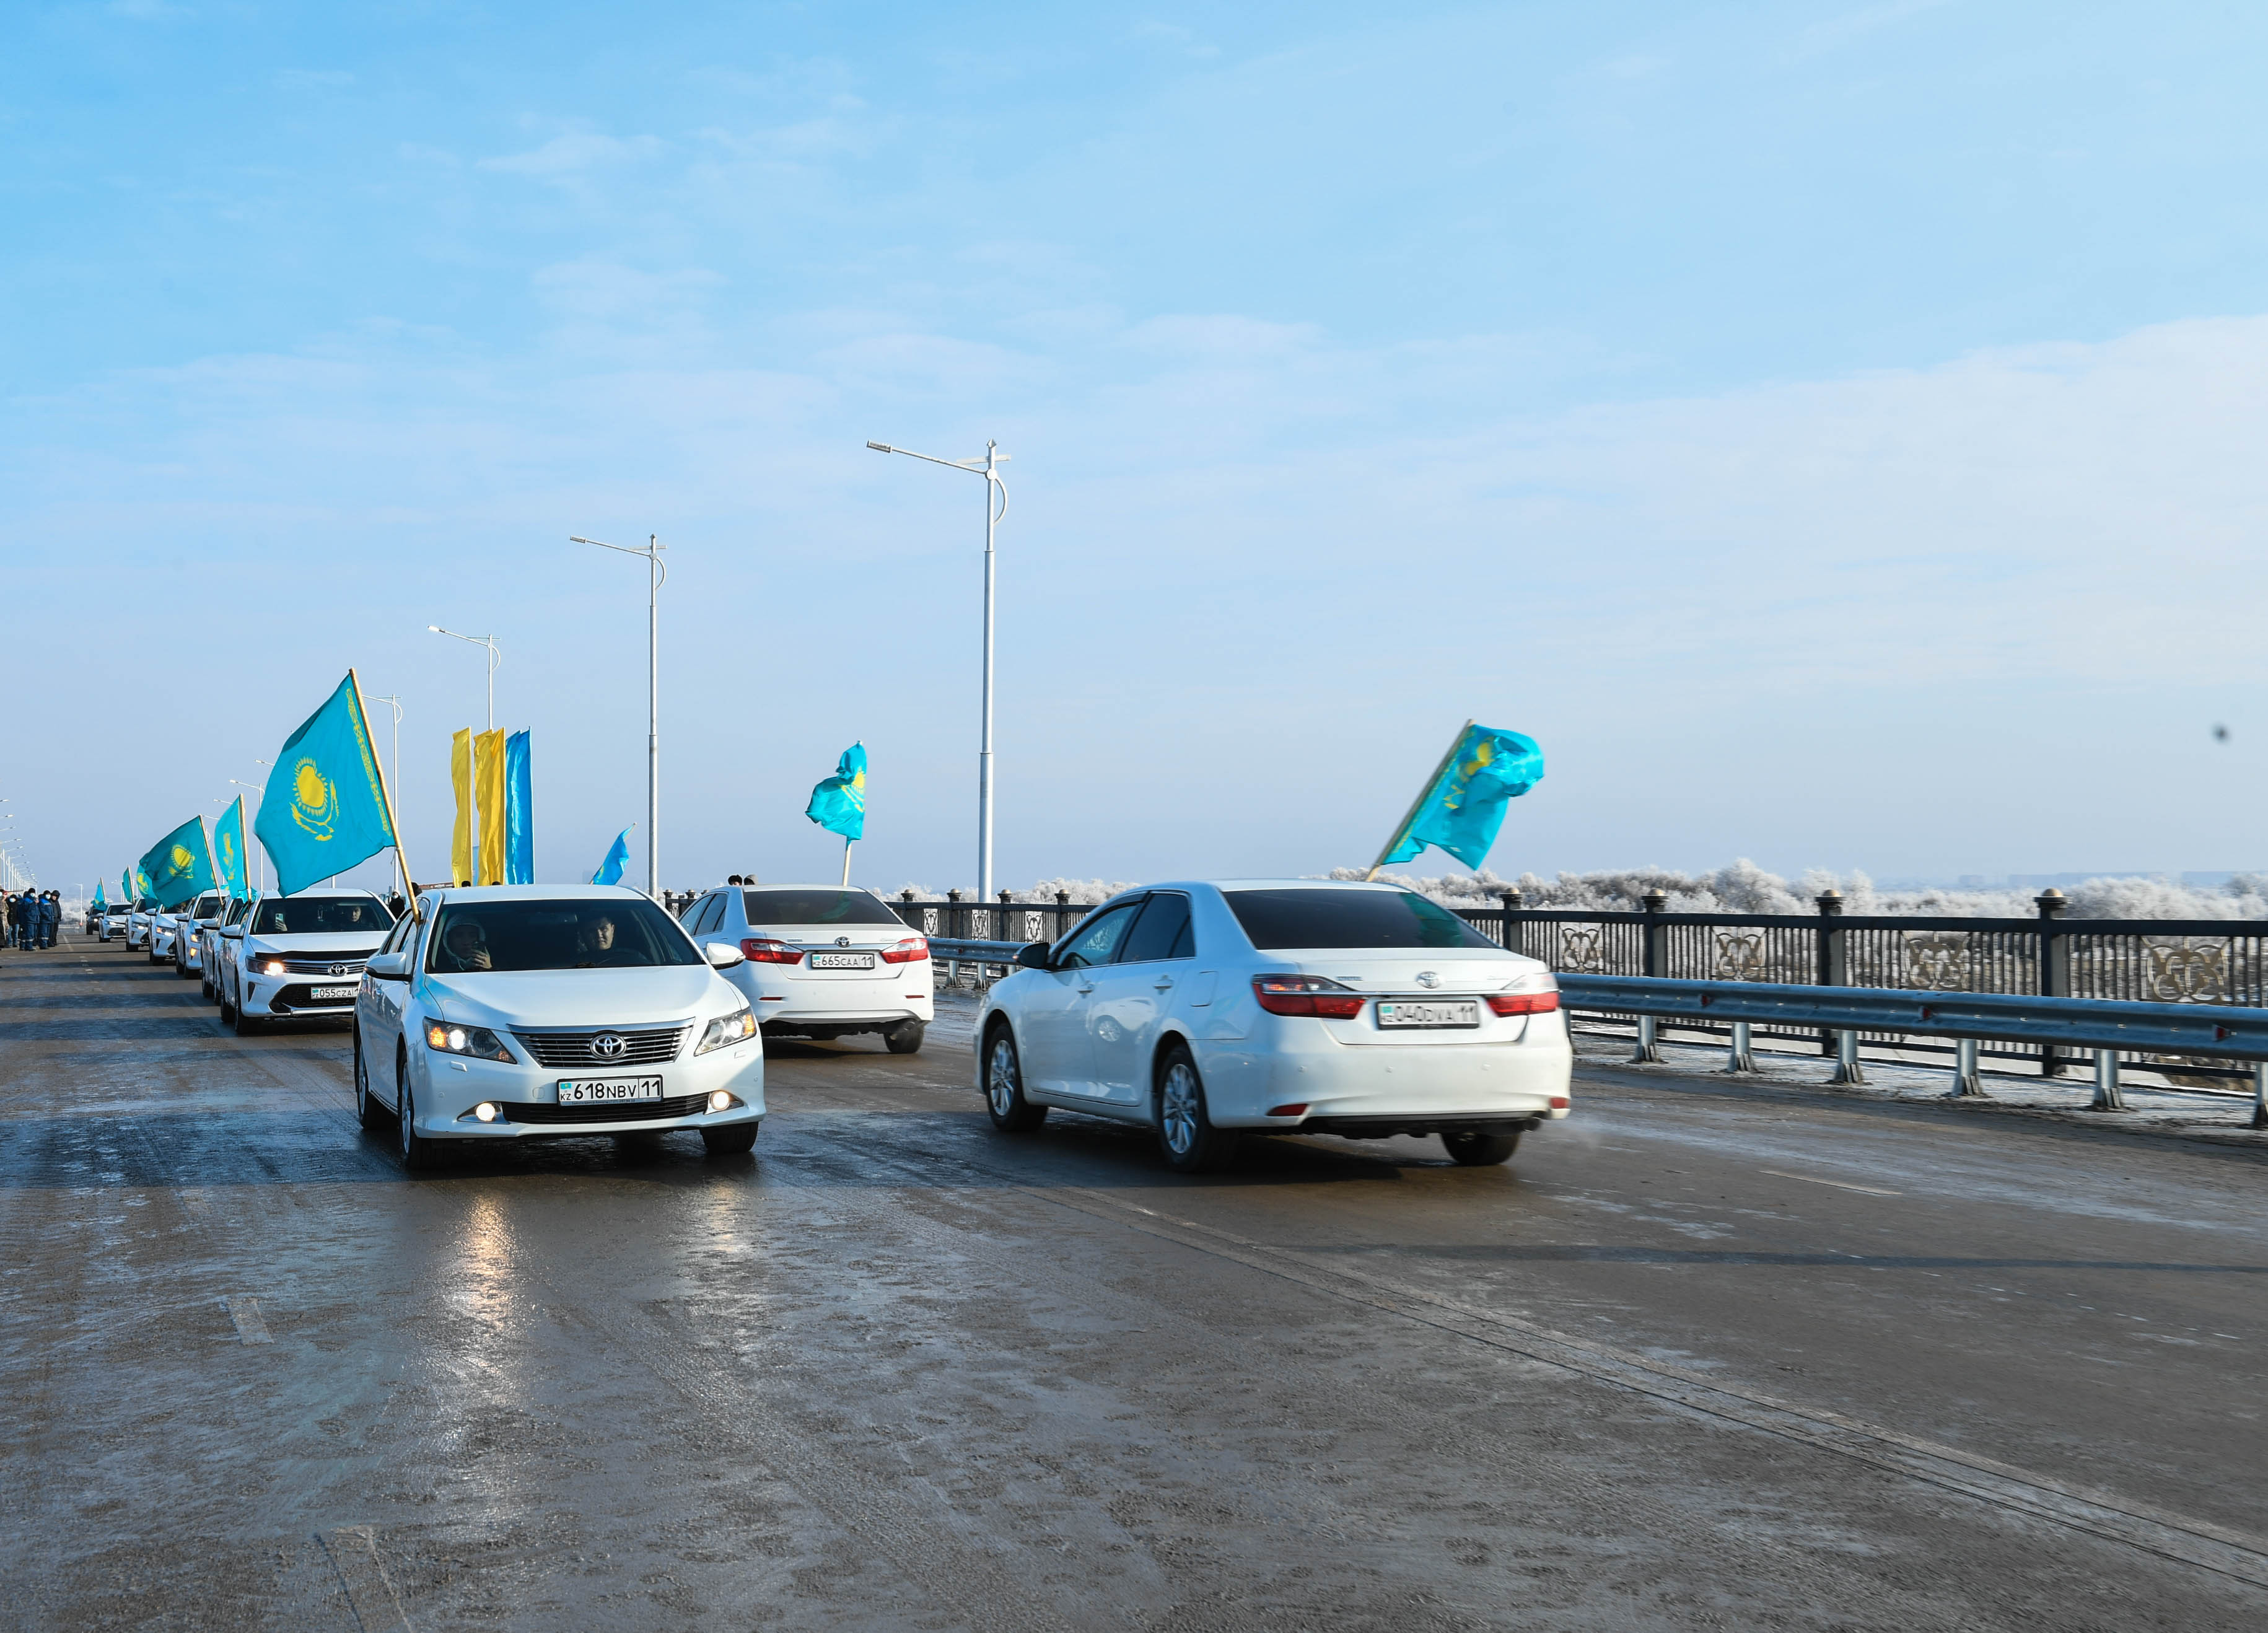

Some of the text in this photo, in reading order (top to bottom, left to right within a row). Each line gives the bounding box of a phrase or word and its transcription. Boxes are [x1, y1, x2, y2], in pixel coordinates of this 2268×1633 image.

[821, 956, 858, 966] 665CAA
[861, 956, 873, 966] 11
[320, 989, 352, 997] 055CZA
[574, 1082, 637, 1100] 618NBV
[641, 1080, 660, 1097] 11
